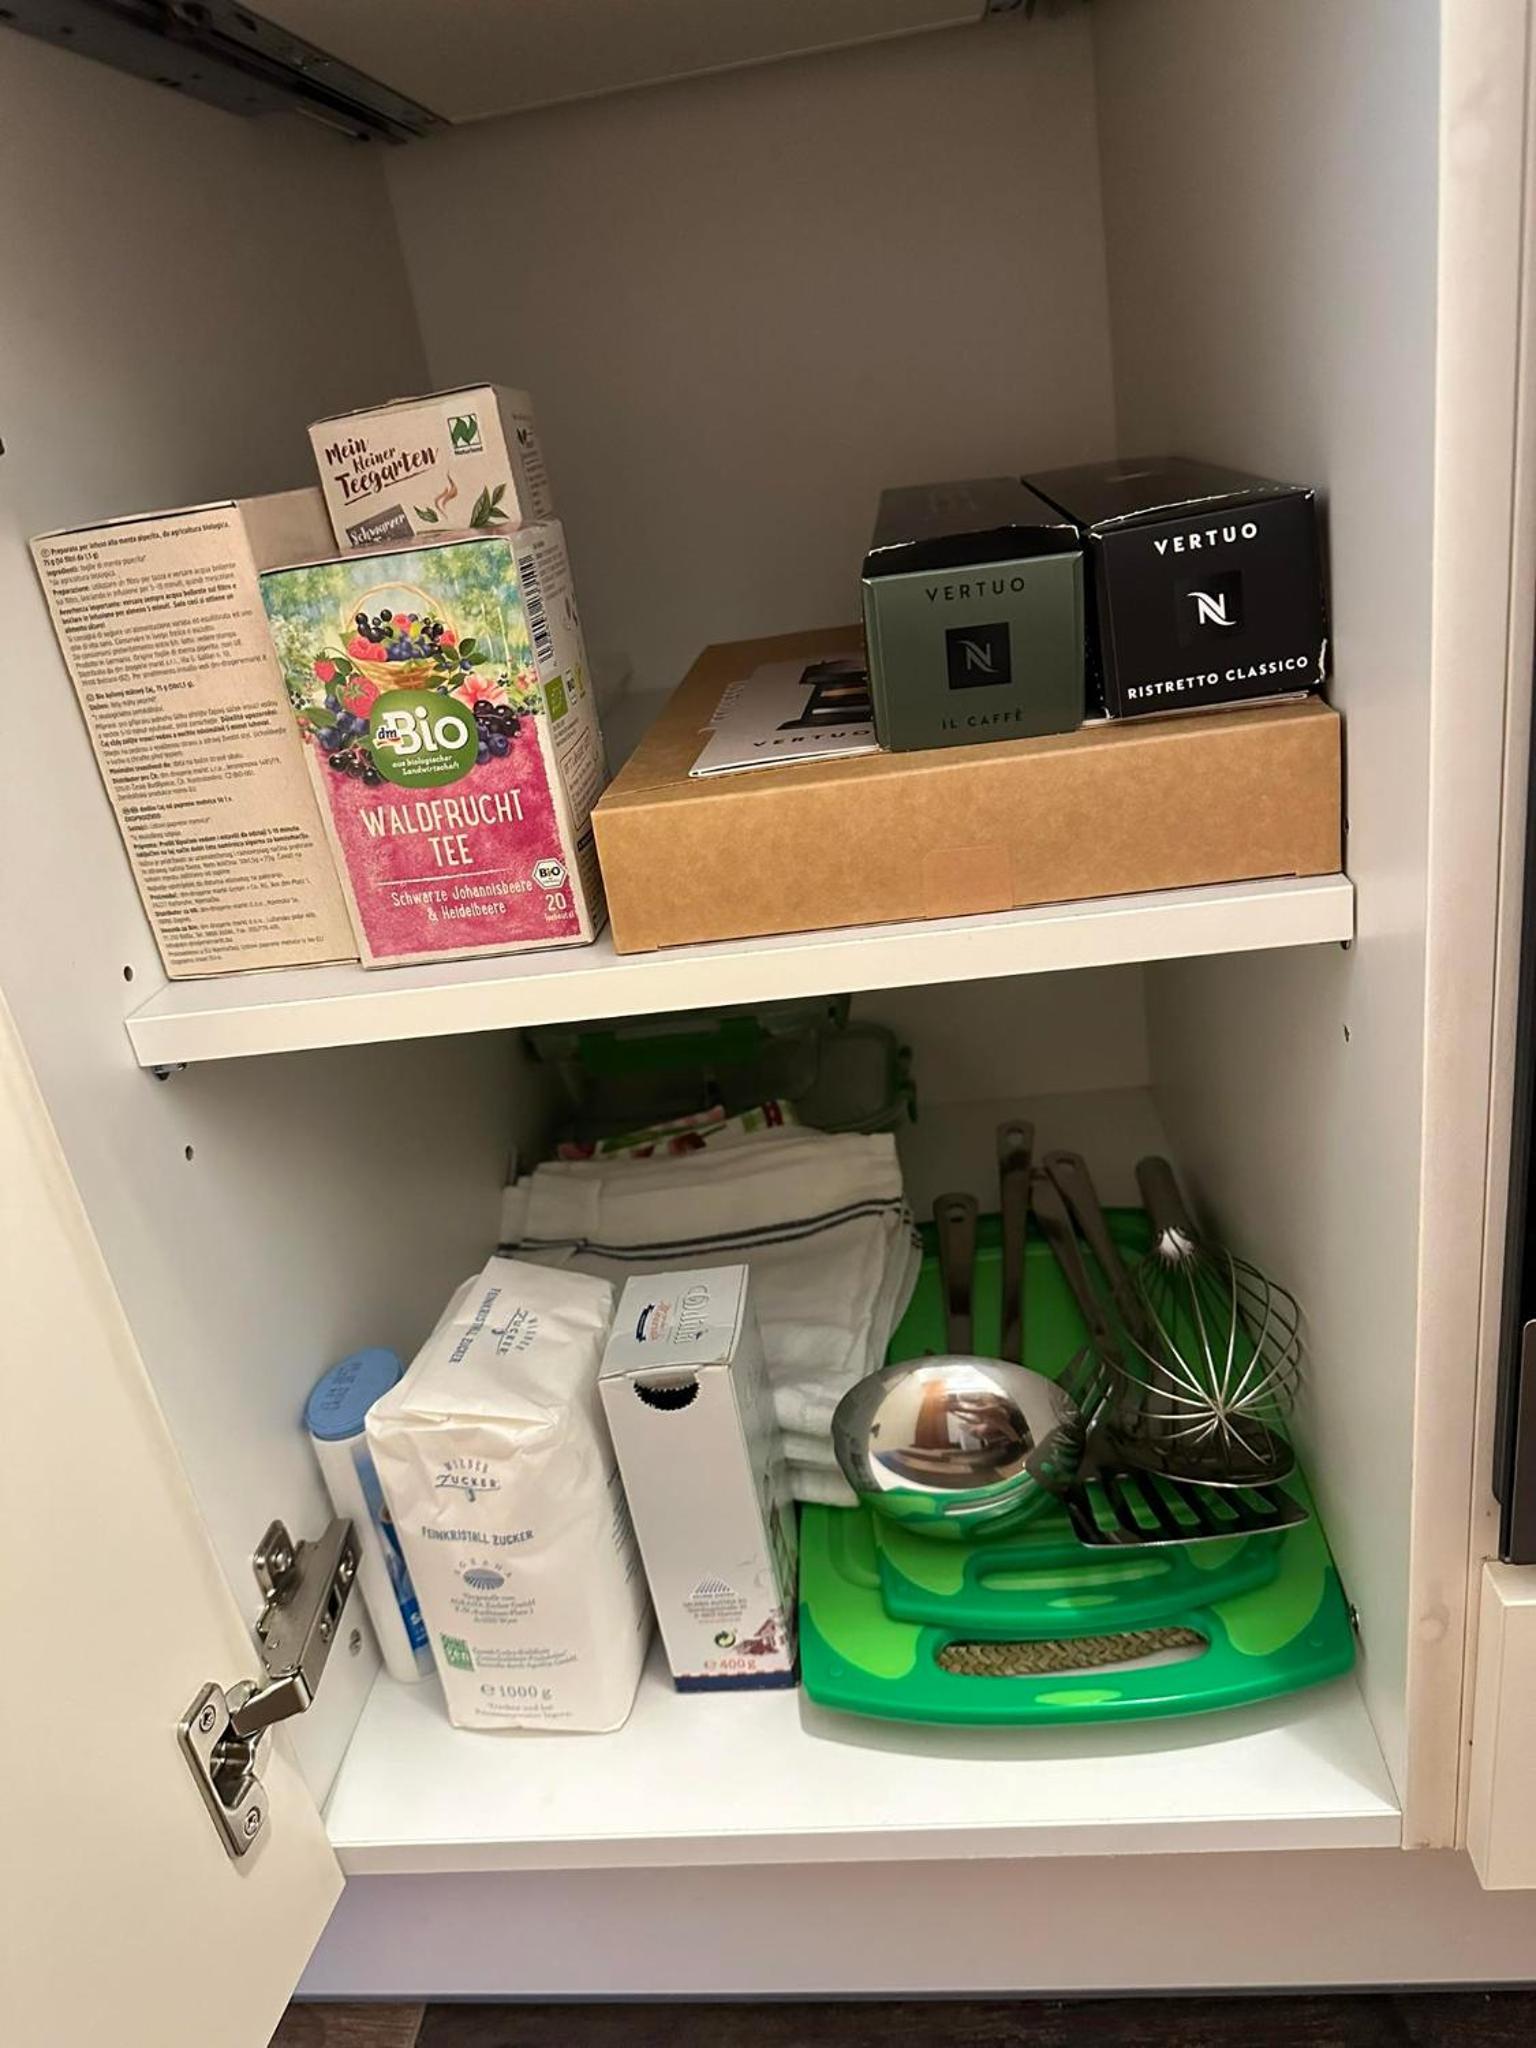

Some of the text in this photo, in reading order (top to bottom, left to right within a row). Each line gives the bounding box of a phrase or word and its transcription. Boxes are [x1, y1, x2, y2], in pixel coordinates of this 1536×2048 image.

[325, 438, 367, 465] Mein
[353, 447, 396, 474] kleiner
[334, 447, 439, 499] Teegarten
[1154, 523, 1257, 555] VERTUO
[926, 577, 1025, 602] VERTUO
[1128, 656, 1308, 699] RISTRETTO CLASSICO
[378, 706, 469, 755] dm Bio
[942, 718, 958, 730] IL
[752, 730, 871, 747] VERTUO
[360, 789, 524, 838] WALDFRUCHT
[428, 834, 474, 867] TEE
[391, 880, 533, 908] Schwarze Johannisbeere
[546, 892, 566, 911] 20
[427, 902, 506, 922] & Heidelbeere
[436, 1473, 498, 1488] ZUCKER
[492, 1530, 534, 1546] ZUCKER
[500, 1685, 552, 1700] 1000 g
